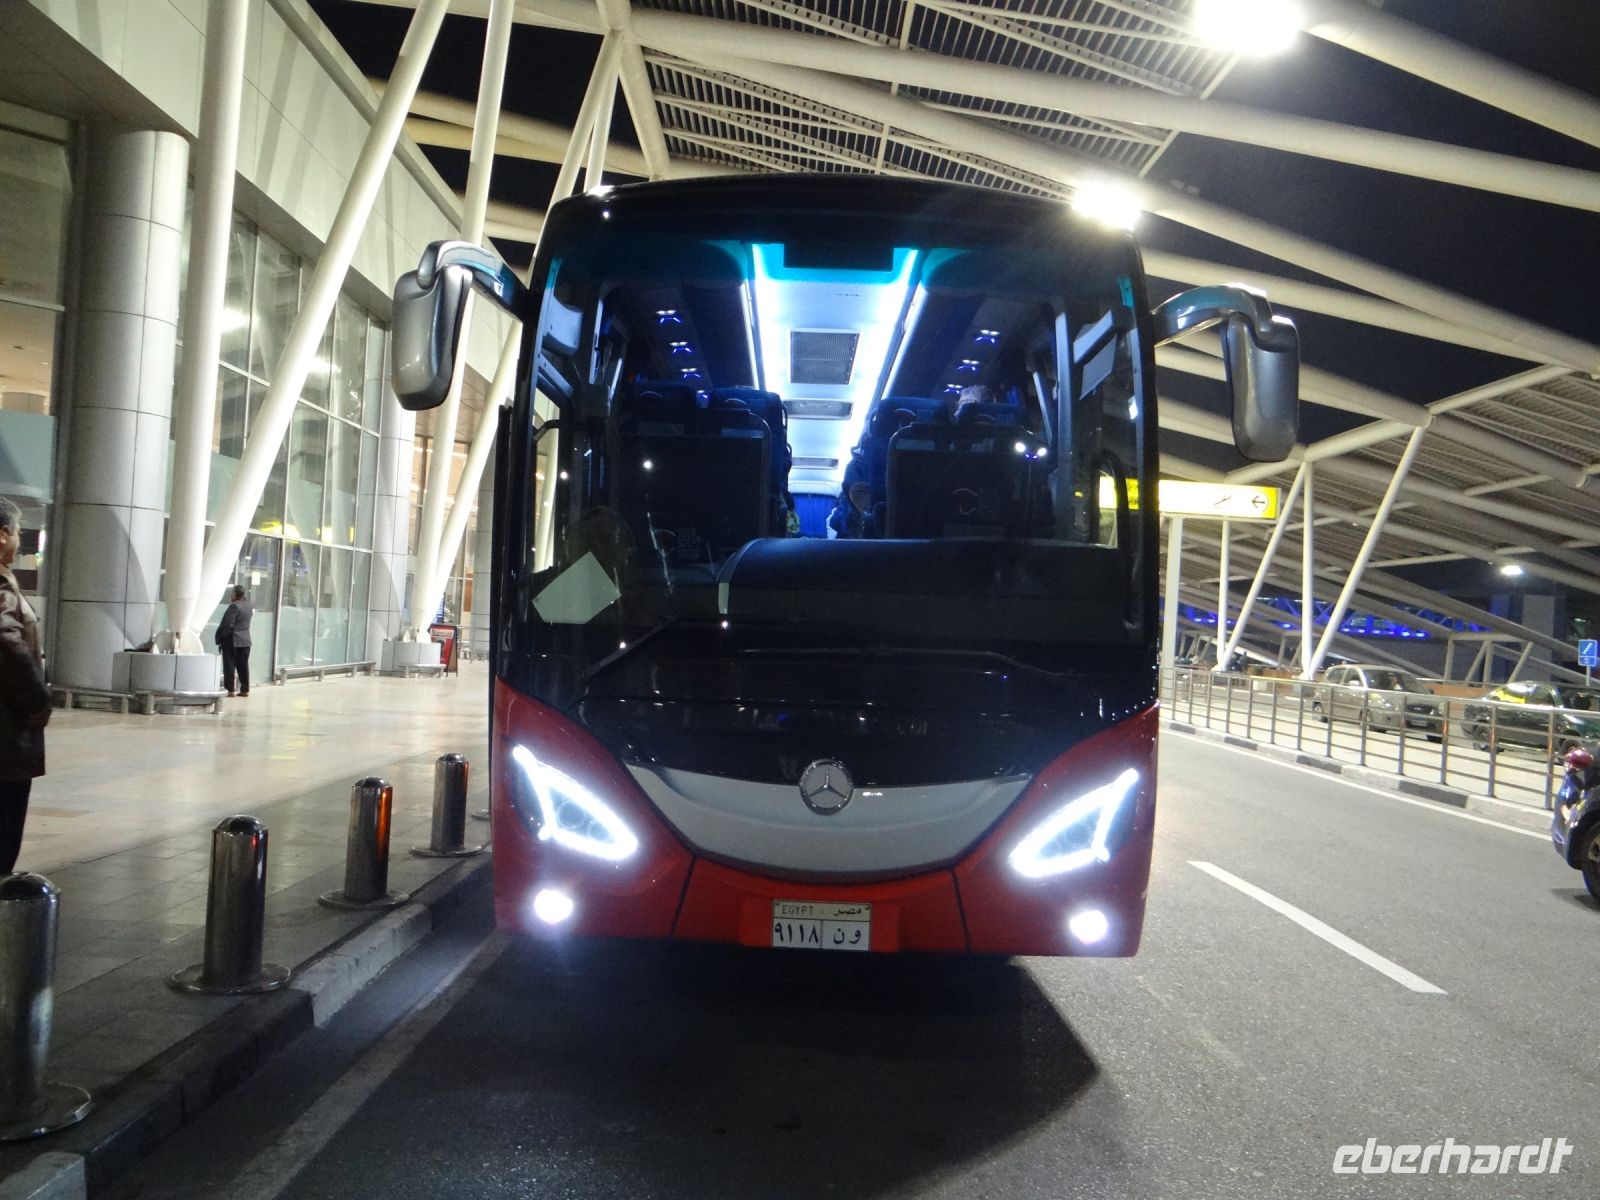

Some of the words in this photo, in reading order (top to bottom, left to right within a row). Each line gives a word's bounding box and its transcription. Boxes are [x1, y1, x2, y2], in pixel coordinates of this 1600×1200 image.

[782, 904, 814, 915] EGYPT
[833, 908, 862, 917] مصر
[774, 922, 819, 944] ٩١١٨
